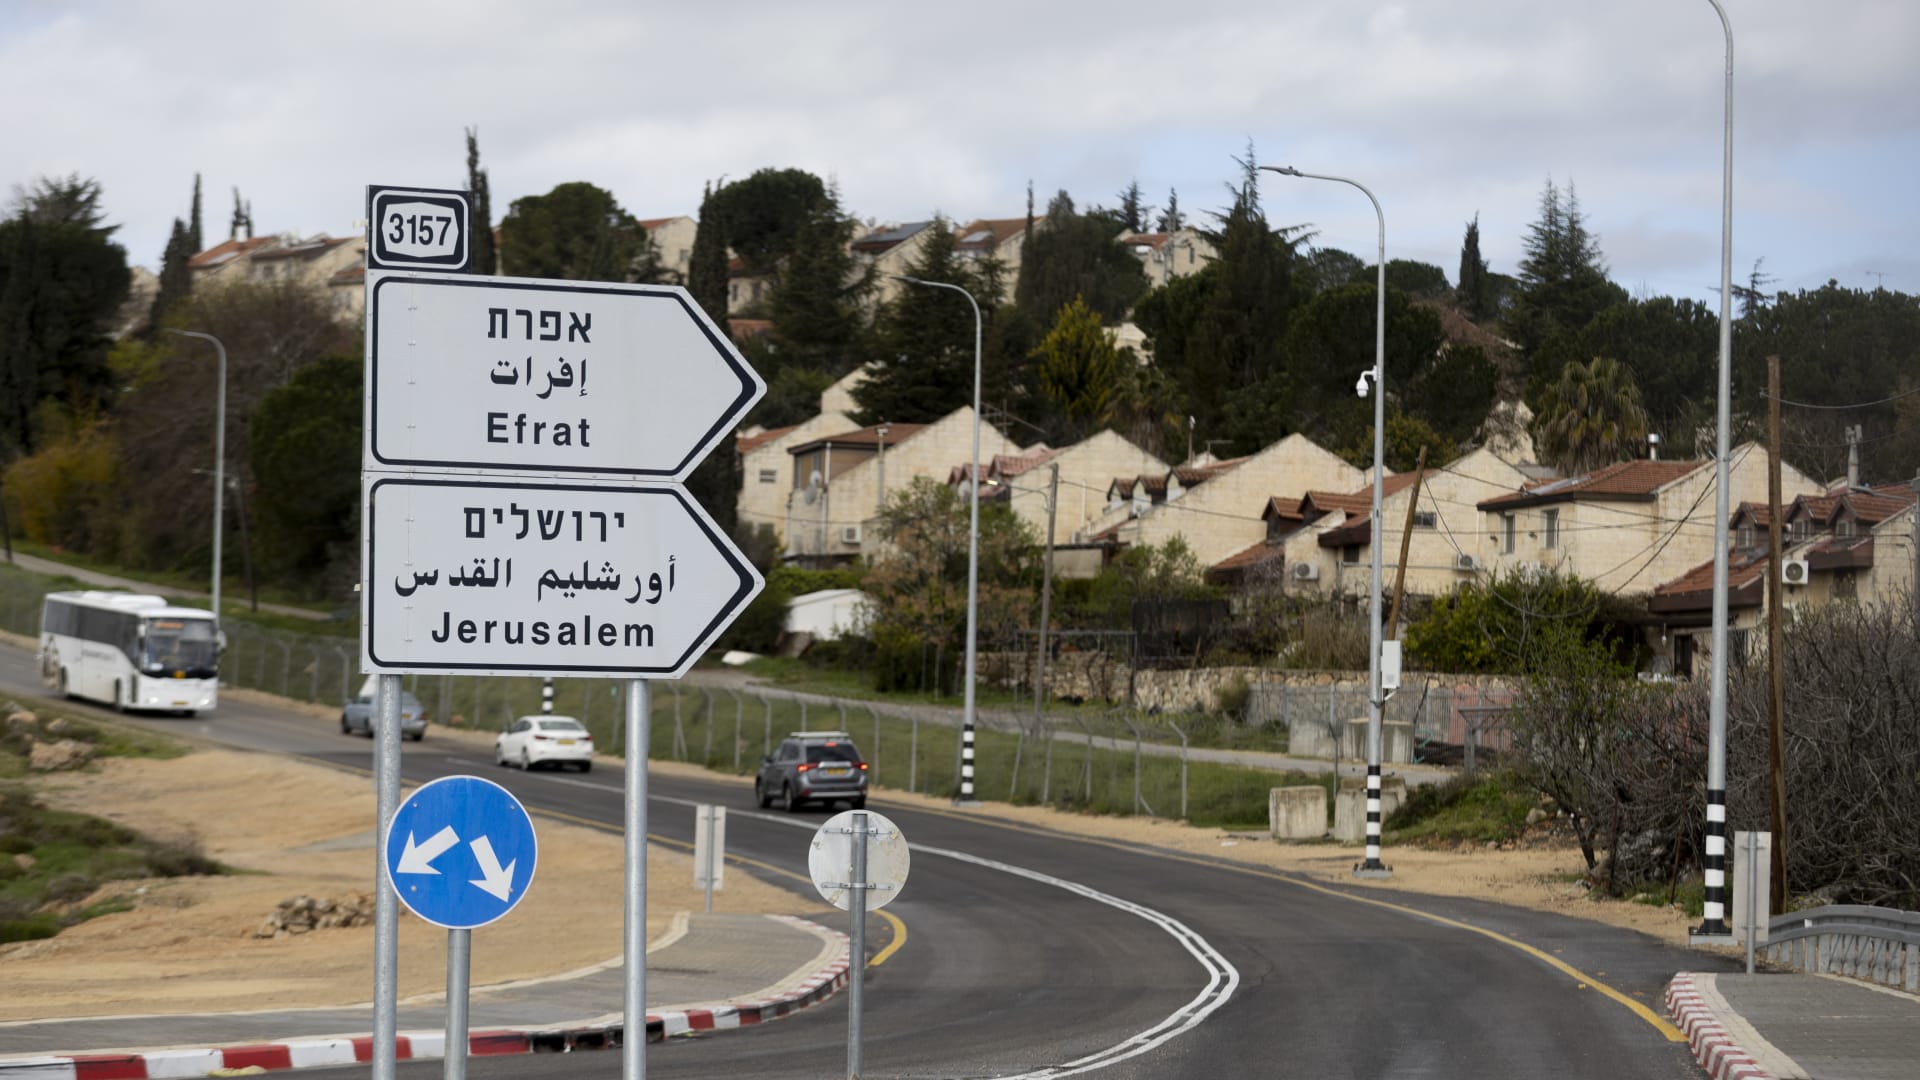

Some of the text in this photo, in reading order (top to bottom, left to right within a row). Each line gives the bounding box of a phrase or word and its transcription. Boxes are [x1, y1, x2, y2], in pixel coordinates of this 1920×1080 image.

[389, 212, 452, 246] 3157
[487, 307, 592, 344] אפרת
[490, 356, 588, 400] إفرات
[487, 411, 590, 448] Efrat
[463, 502, 625, 543] ירושלים
[394, 554, 676, 605] أورشليم القدس
[431, 611, 654, 647] Jerusalem
